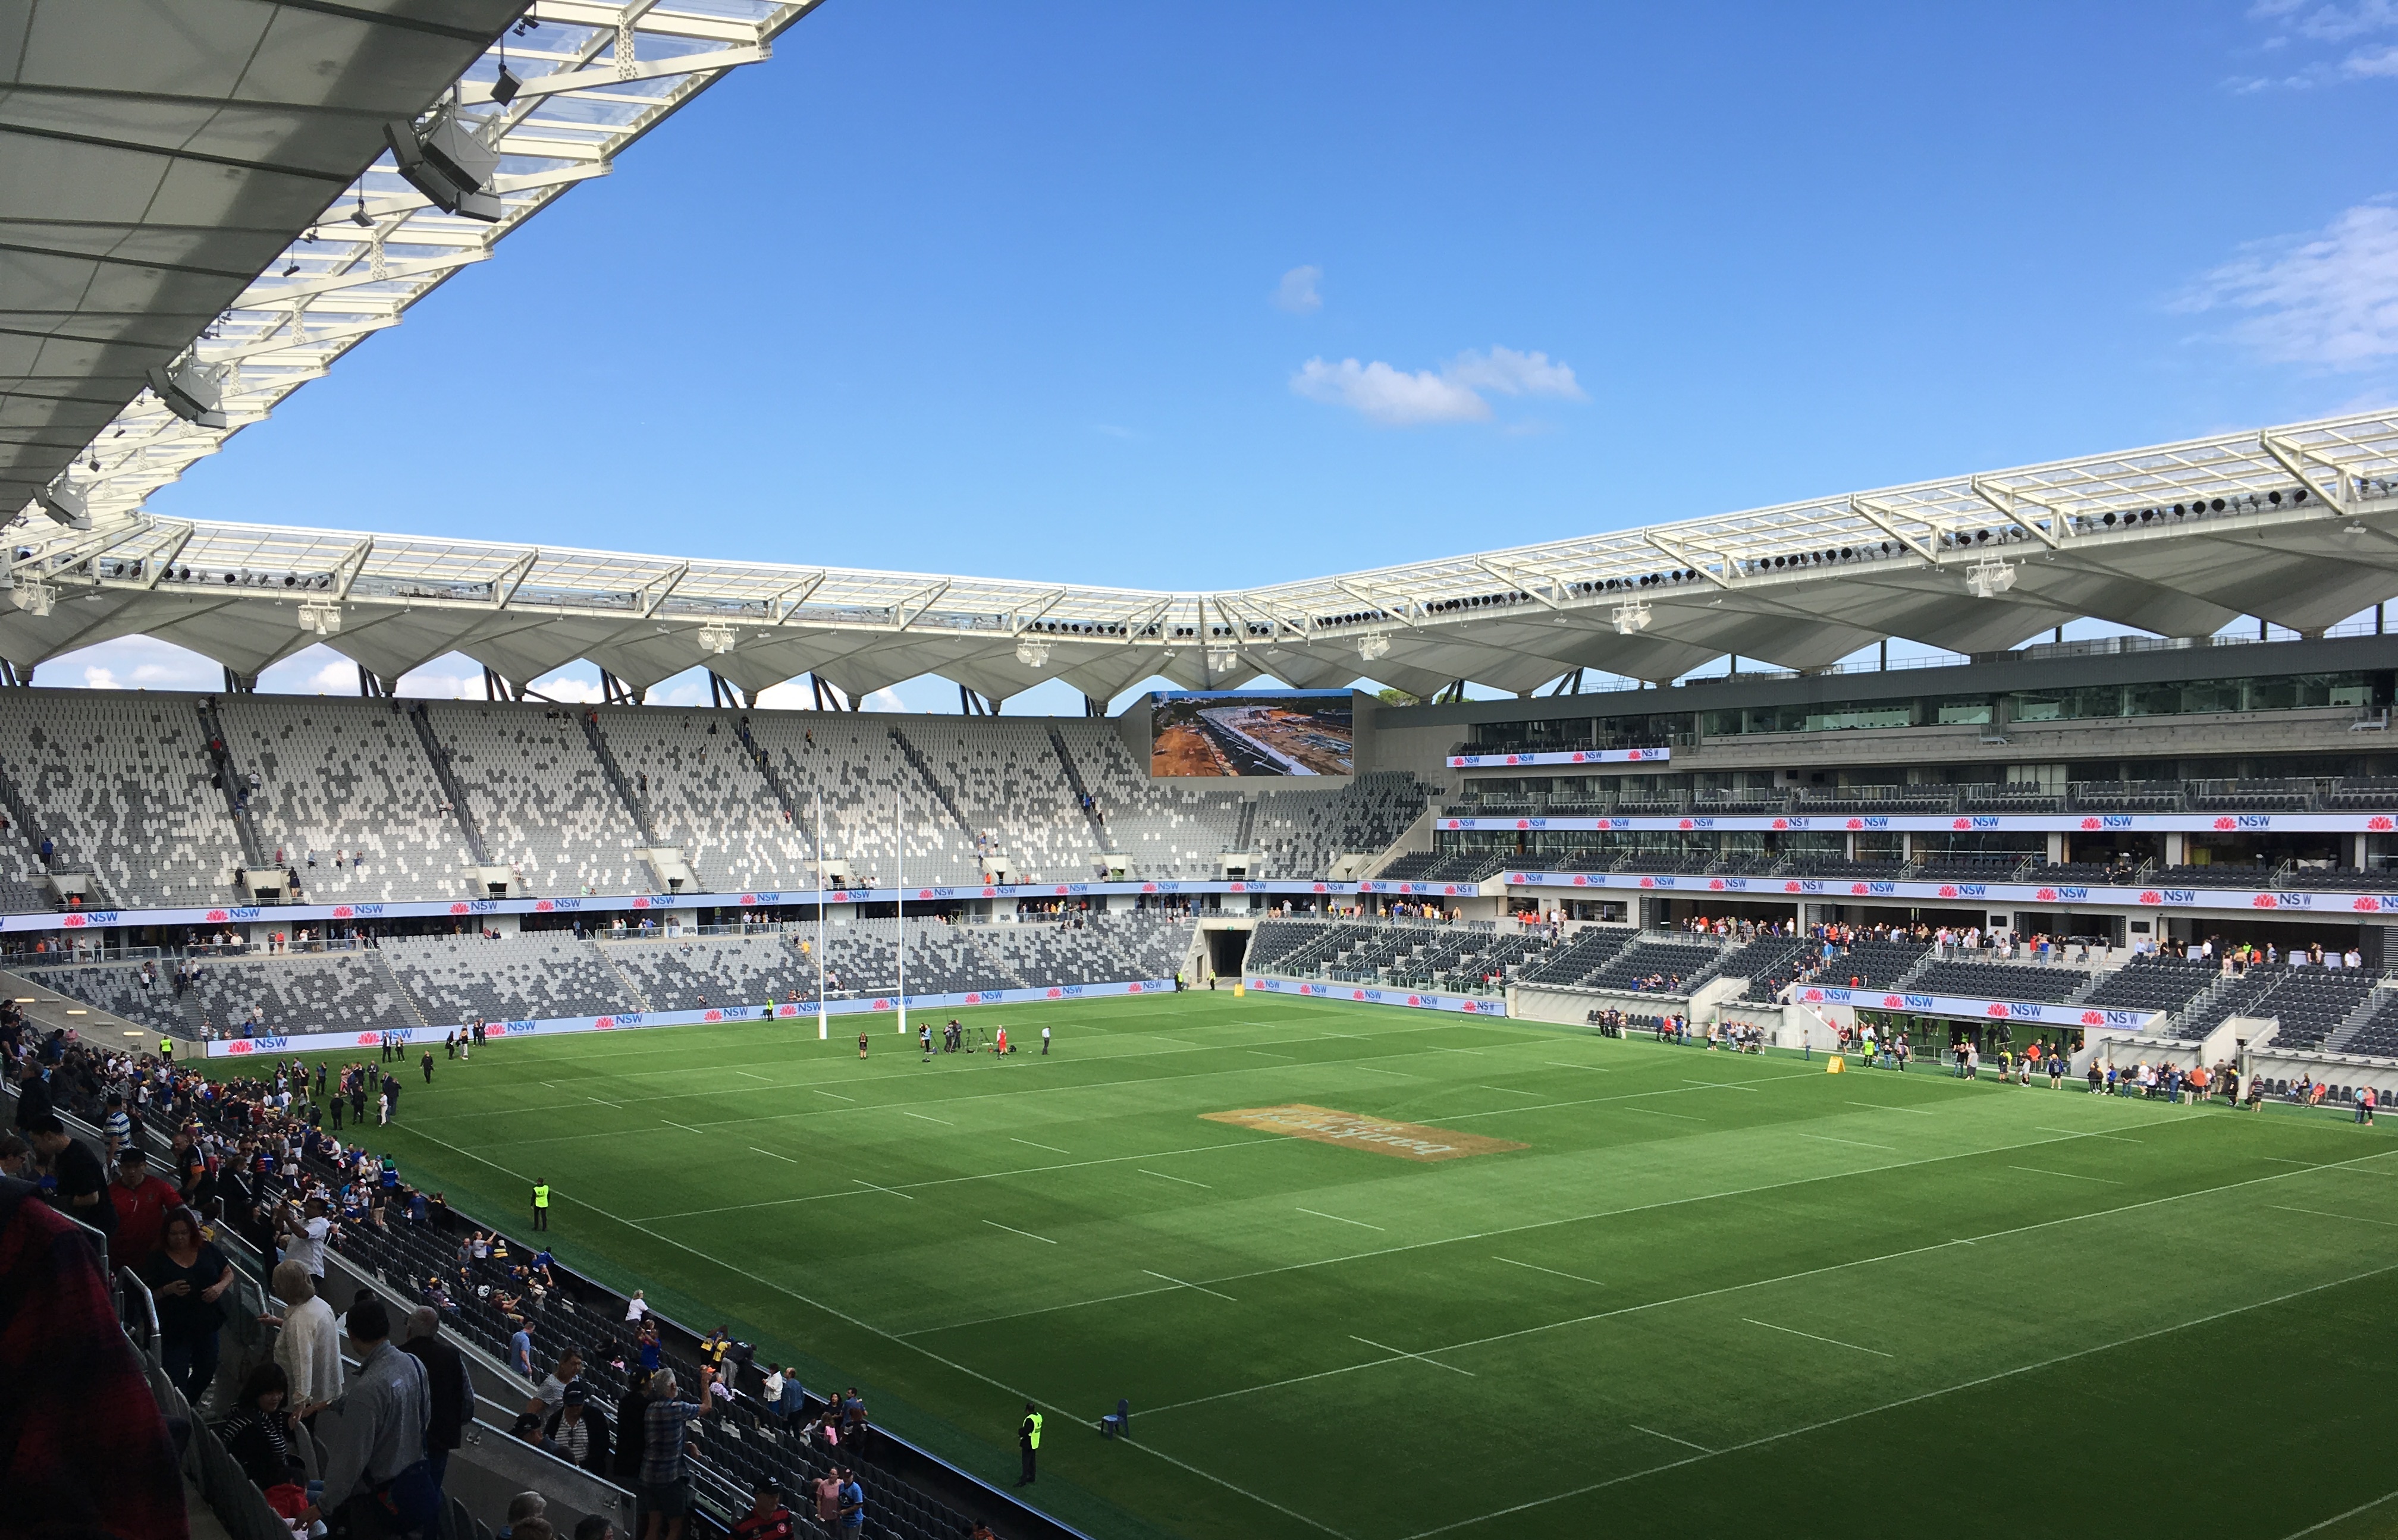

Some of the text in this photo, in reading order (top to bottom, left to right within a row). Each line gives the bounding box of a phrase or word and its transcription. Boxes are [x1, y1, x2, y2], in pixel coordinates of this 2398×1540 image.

[1865, 818, 1888, 826] NSW
[1973, 818, 1999, 826] NSW
[2104, 816, 2132, 826] NSW
[2239, 816, 2270, 826] NSW
[1655, 877, 1674, 885] NSW
[1726, 879, 1746, 887] NSW
[1870, 883, 1894, 892] NSW
[1960, 885, 1985, 895] NSW
[2059, 888, 2088, 898] NSW
[2164, 891, 2195, 901] NSW
[555, 899, 580, 908] NSW
[651, 896, 674, 904] NSW
[356, 904, 383, 913] NSW
[471, 901, 497, 910] NSW
[88, 912, 117, 922] NSW
[230, 908, 260, 917] NSW
[1312, 985, 1326, 993] NSW
[982, 991, 1002, 1000] NSW
[1366, 990, 1381, 999] NSW
[1825, 989, 1851, 1000] NSW
[890, 997, 912, 1005] NW
[1421, 996, 1437, 1005] NSW
[1906, 995, 1933, 1007] NSW
[799, 1002, 821, 1011] NSW
[2011, 1004, 2041, 1016] NSW
[724, 1007, 748, 1016] NSW
[616, 1014, 642, 1024] NSW
[508, 1021, 535, 1031] NSW
[255, 1037, 287, 1048] NSW
